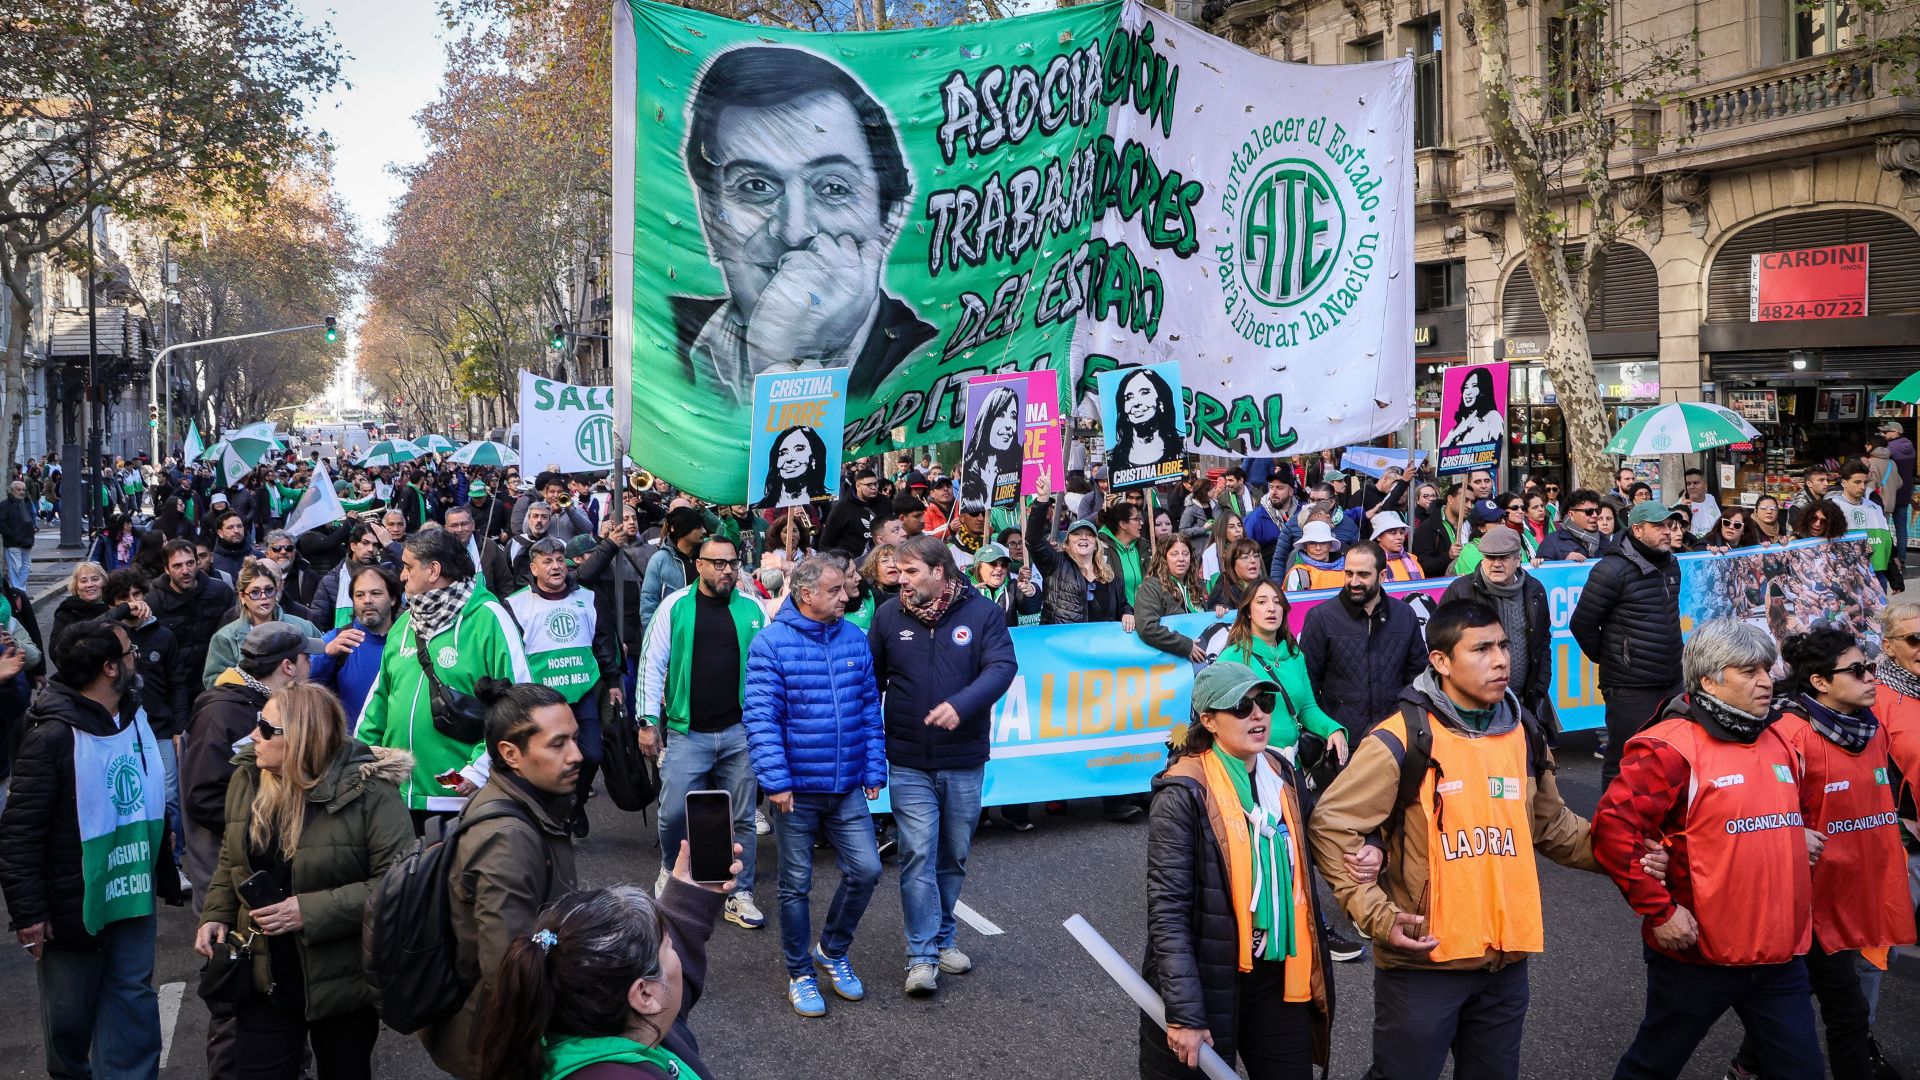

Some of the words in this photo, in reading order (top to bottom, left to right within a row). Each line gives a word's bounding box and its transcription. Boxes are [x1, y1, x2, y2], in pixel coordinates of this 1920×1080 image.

[936, 23, 1179, 166] ASOCIACIÓN
[1221, 117, 1305, 221] Fortalecer
[1307, 116, 1327, 146] el
[1325, 122, 1383, 212] Estado
[926, 134, 1204, 275] TRABAJADORES
[1245, 168, 1333, 298] ATE
[1763, 246, 1865, 270] CARDINI
[1215, 242, 1239, 315] para
[1231, 298, 1299, 348] liberar
[1301, 310, 1329, 341] la
[1319, 231, 1380, 327] Nación
[1751, 259, 1759, 317] VENDE
[940, 269, 1033, 365] DEL
[1761, 301, 1863, 319] 4824-0722
[769, 375, 832, 399] CRISTINA
[765, 400, 829, 433] LIBRE
[1440, 453, 1475, 468] CRISTINA
[1475, 450, 1495, 463] LIBRE
[997, 471, 1018, 484] CRISTINA
[1113, 464, 1157, 485] CRISTINA
[1157, 460, 1184, 476] LIBRE
[995, 483, 1017, 500] LIBRE
[552, 614, 573, 636] ATE
[548, 656, 584, 670] HOSPITAL
[543, 674, 570, 687] RAMOS
[1039, 663, 1176, 739] LIBRE
[1717, 773, 1744, 788] CTA
[1824, 780, 1850, 793] CTA
[1441, 829, 1474, 861] LA
